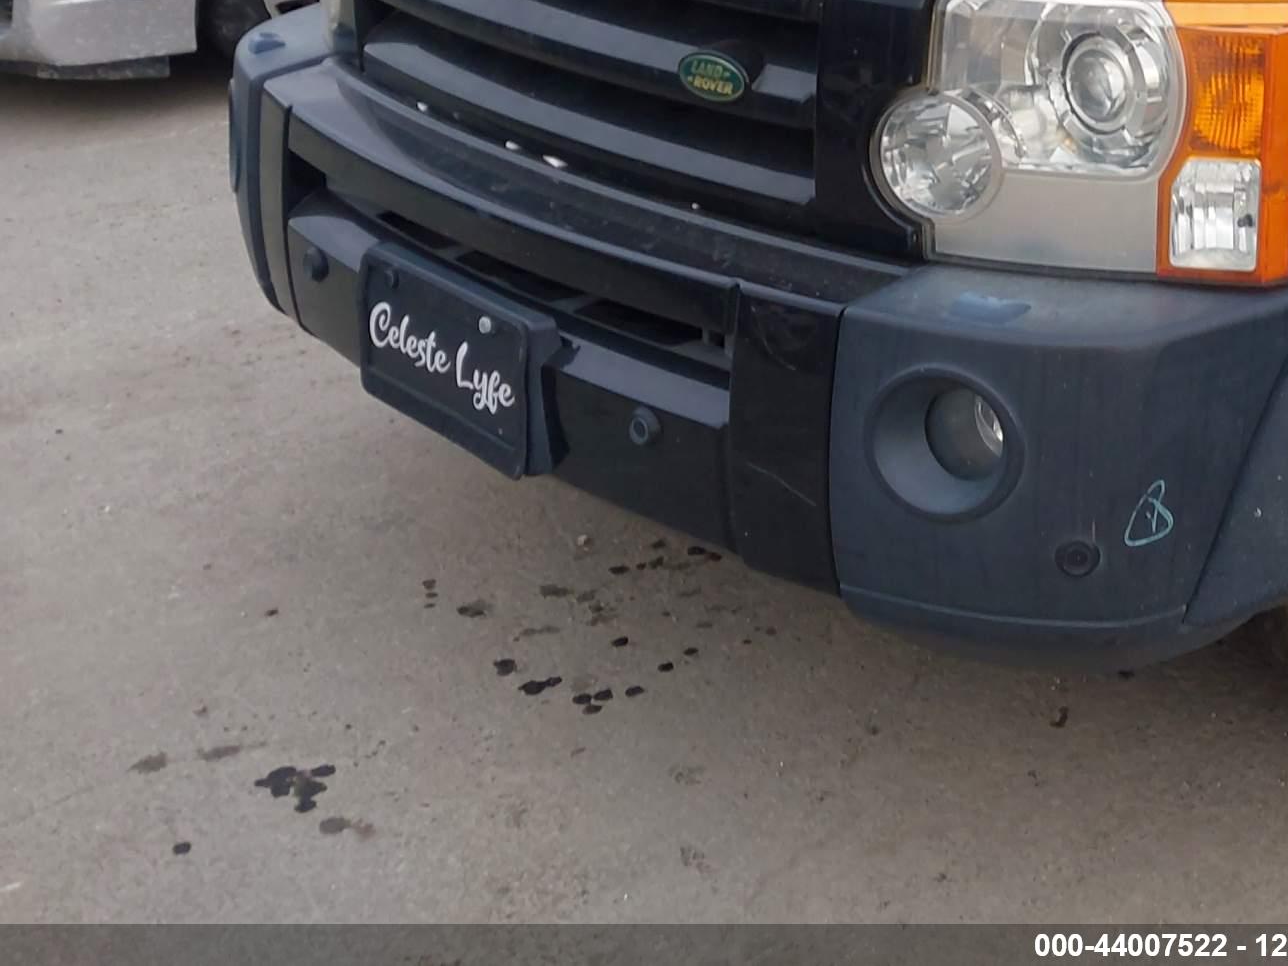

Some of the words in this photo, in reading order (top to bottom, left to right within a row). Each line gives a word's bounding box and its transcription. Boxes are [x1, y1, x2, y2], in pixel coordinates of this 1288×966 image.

[691, 60, 724, 76] LAND
[693, 75, 734, 95] ROVER
[369, 301, 452, 373] Celeste
[456, 341, 515, 415] Lyfe
